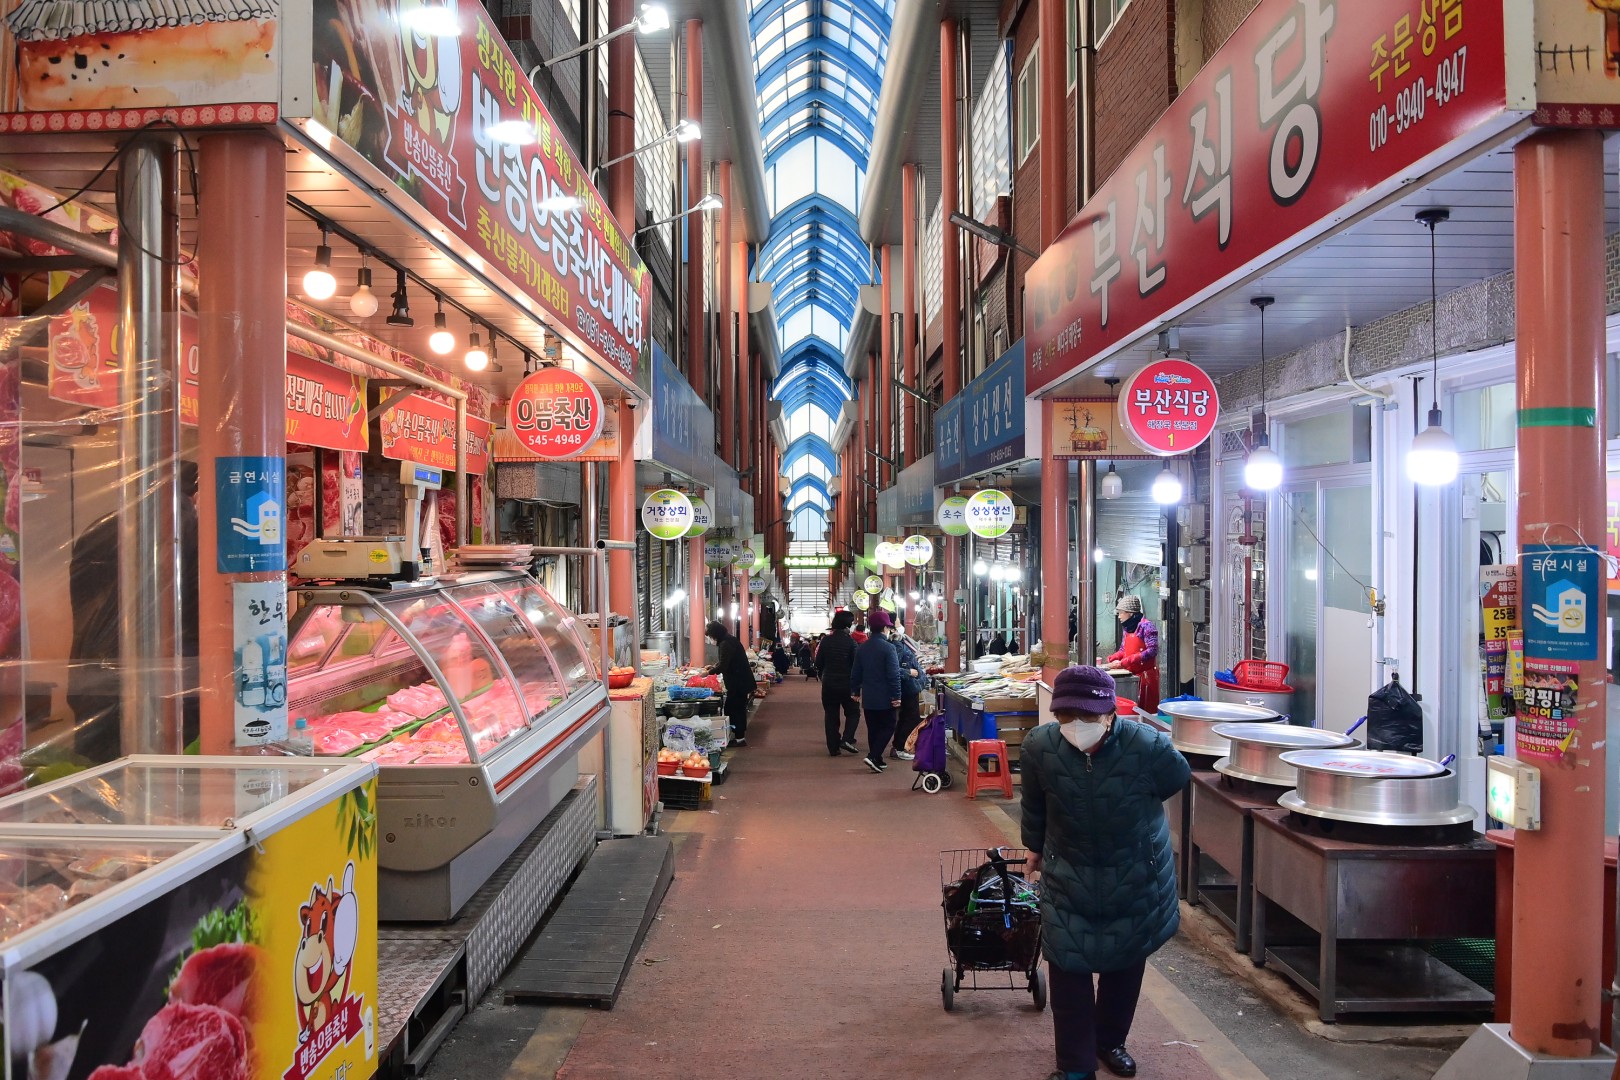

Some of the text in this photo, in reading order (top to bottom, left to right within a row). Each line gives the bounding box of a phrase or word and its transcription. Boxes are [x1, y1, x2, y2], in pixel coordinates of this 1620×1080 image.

[1369, 45, 1467, 152] 010-9940-4947
[476, 15, 517, 106] 정직한
[521, 85, 552, 159] 고기를
[555, 138, 572, 187] 착한
[575, 168, 602, 231] 가격으로
[403, 119, 452, 191] 반송으뜸축산
[1090, 0, 1335, 327] 부산식당
[477, 205, 569, 319] 축산물직거래장터
[286, 374, 324, 417] 전문매장
[1134, 388, 1210, 417] 부산식당
[516, 396, 592, 432] 으뜸축산
[972, 376, 1012, 447] 싱싱생선
[528, 434, 582, 446] 545-4948
[940, 413, 959, 462] 옷수선
[1167, 433, 1175, 447] 1
[229, 471, 281, 485] 금연시설
[646, 505, 688, 517] 거창상회
[971, 505, 1011, 516] 싱싱생선
[1532, 559, 1588, 573] 금연시설
[249, 599, 284, 626] 한우
[1493, 608, 1516, 621] 25평
[1523, 687, 1561, 707] 점핑!
[1521, 706, 1563, 720] 다이어트
[300, 1006, 349, 1075] 반송으뜸축산
